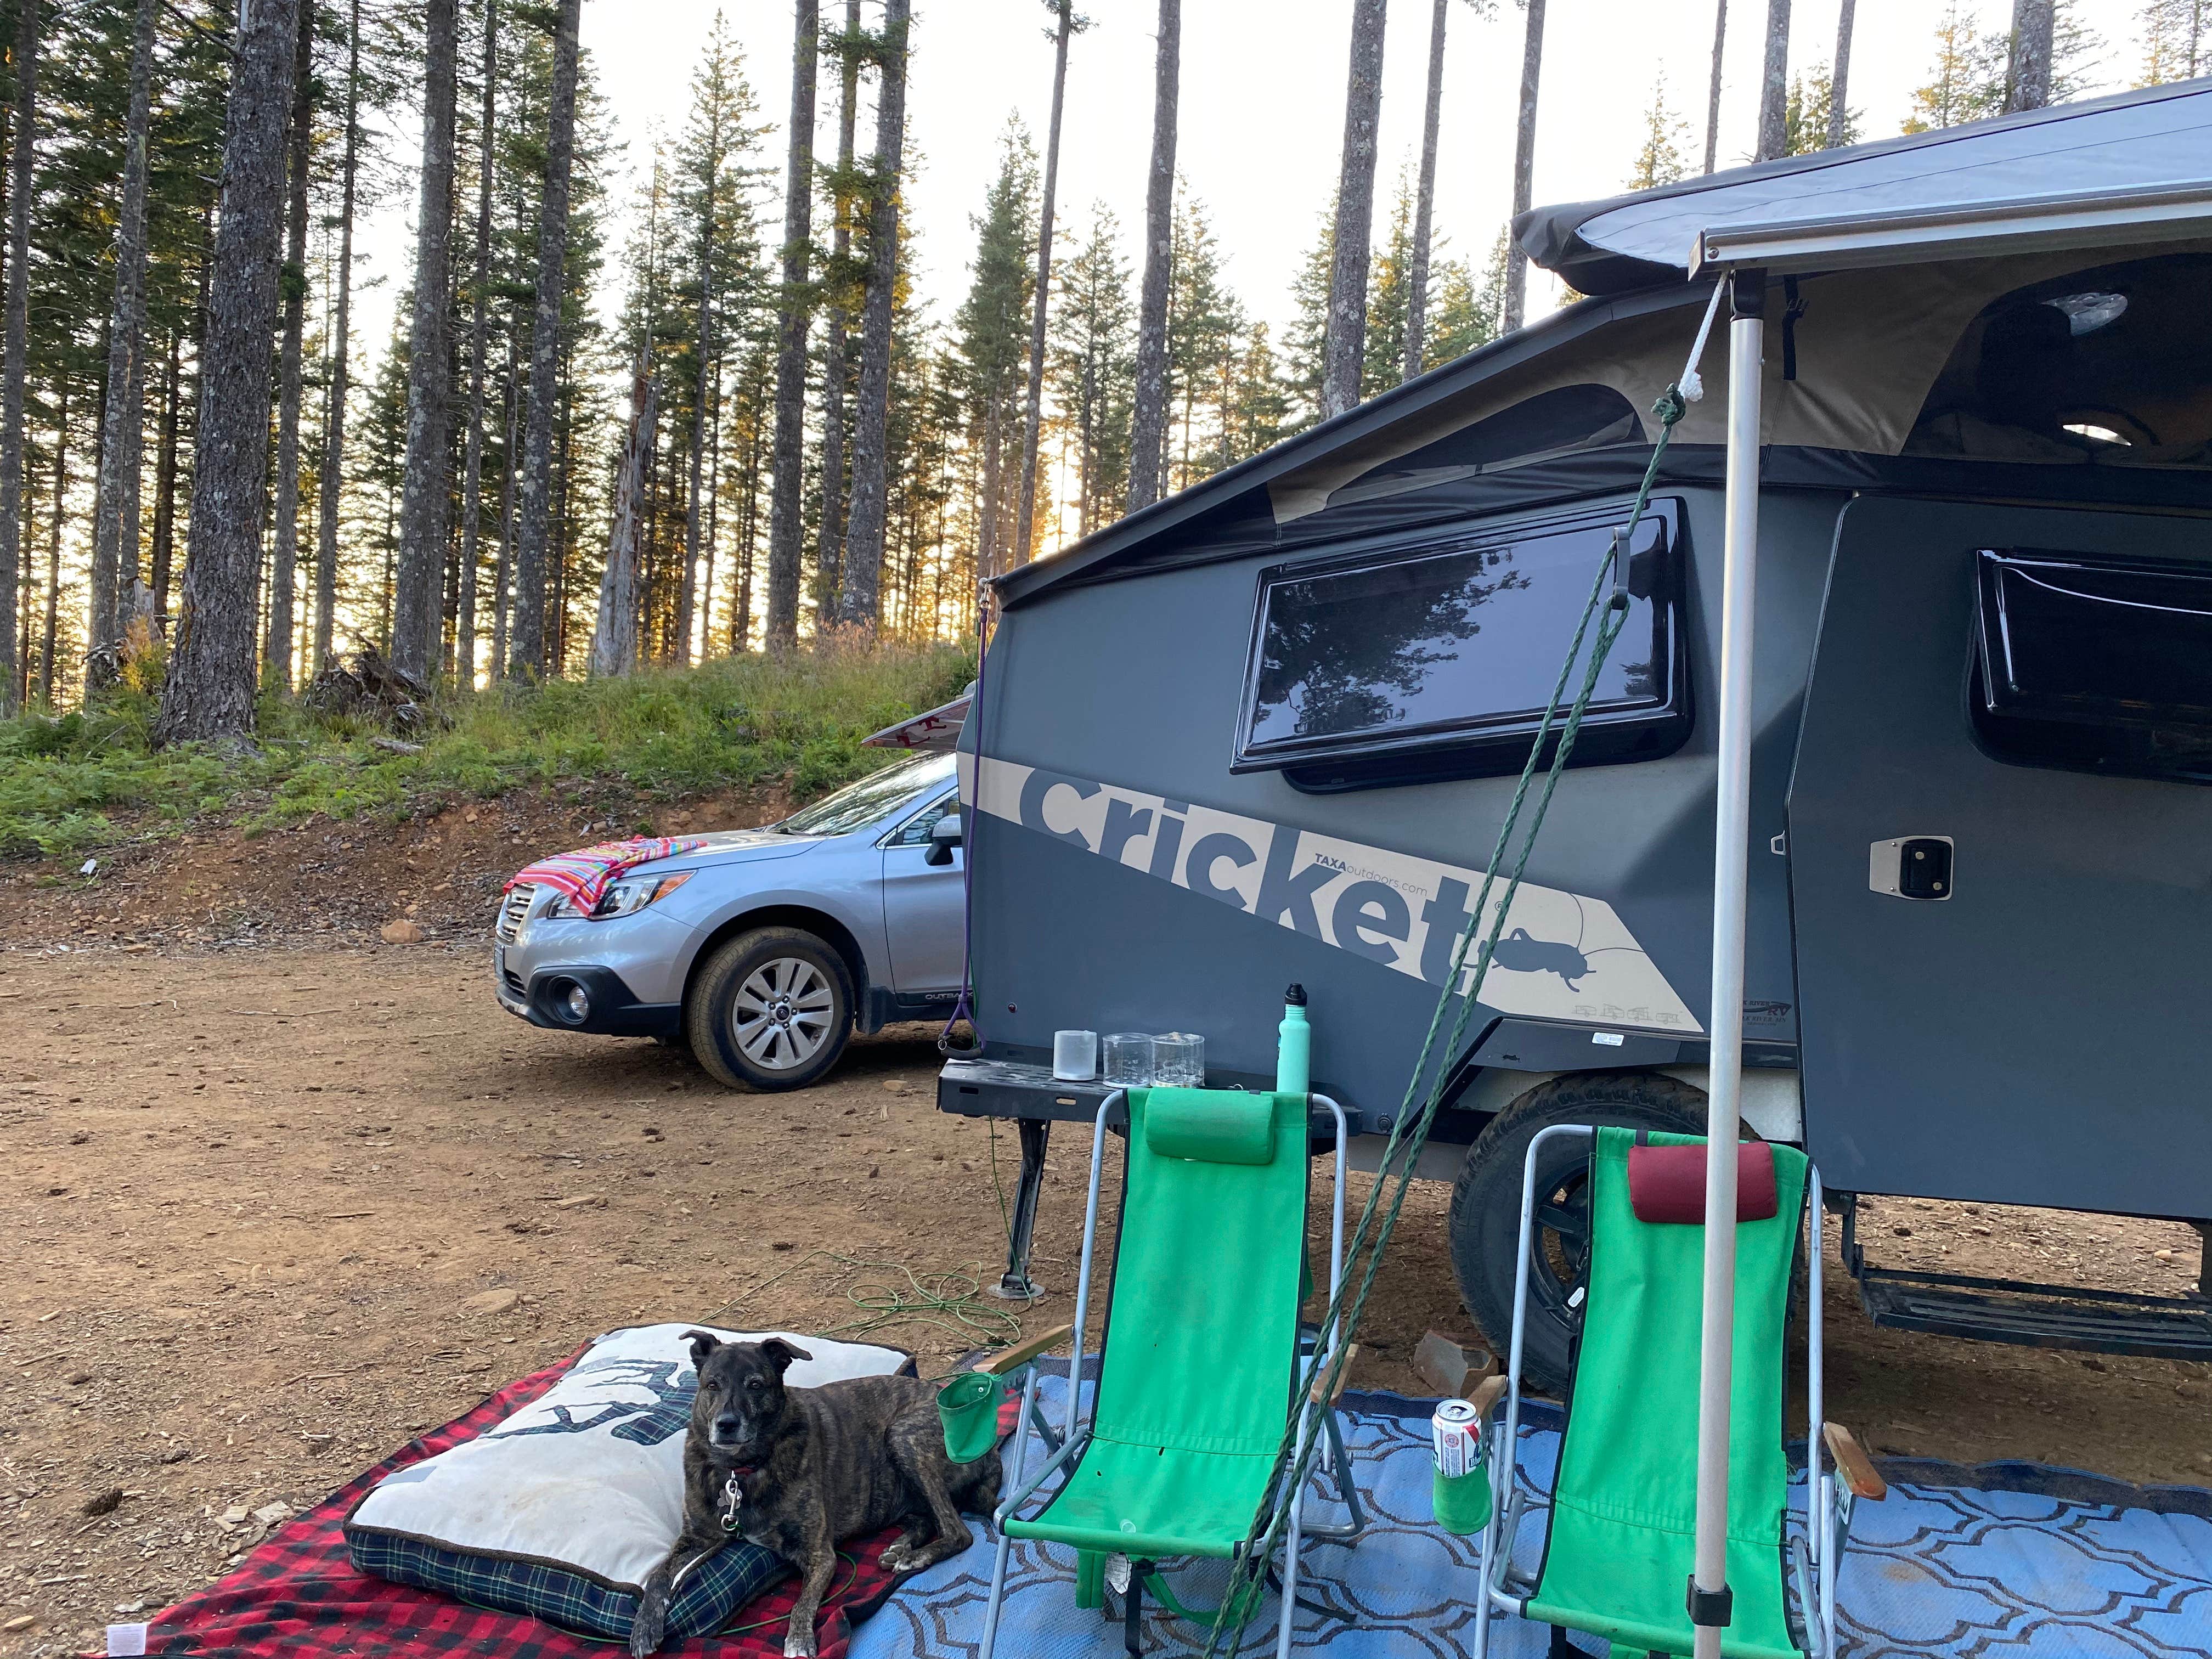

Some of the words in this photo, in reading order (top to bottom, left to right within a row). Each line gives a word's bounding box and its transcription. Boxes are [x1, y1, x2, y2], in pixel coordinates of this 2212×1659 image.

[1019, 767, 1481, 992] cricket
[1314, 853, 1428, 897] TAXAoutdoors.com
[925, 991, 973, 1000] OUTBAK
